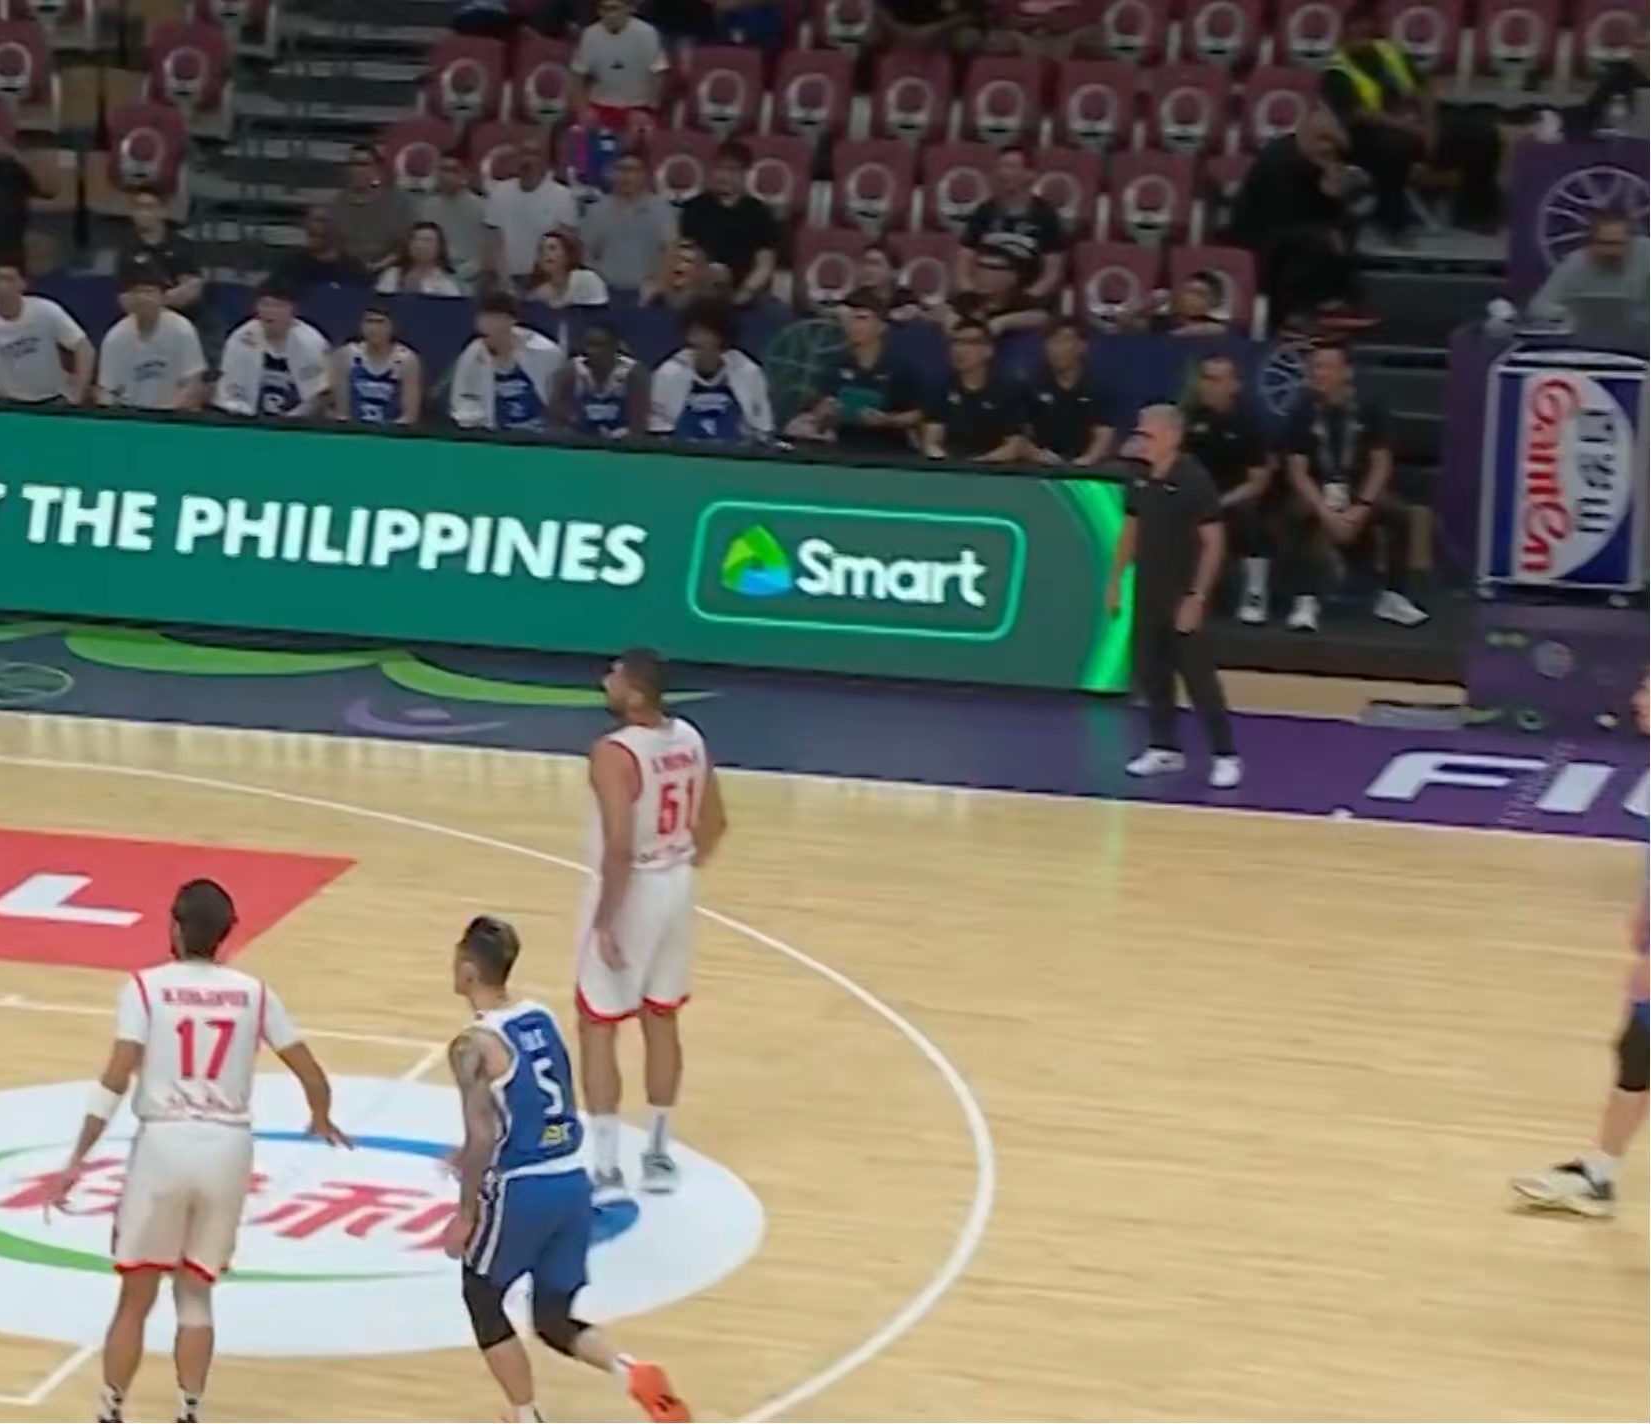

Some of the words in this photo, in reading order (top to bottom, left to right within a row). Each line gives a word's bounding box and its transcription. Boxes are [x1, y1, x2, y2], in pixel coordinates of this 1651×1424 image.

[22, 483, 157, 551] THE
[175, 495, 649, 587] PHILIPPINES
[795, 537, 987, 608] Smart
[1364, 750, 1650, 818] FI
[176, 1017, 236, 1080] 17
[531, 1057, 564, 1115] 5
